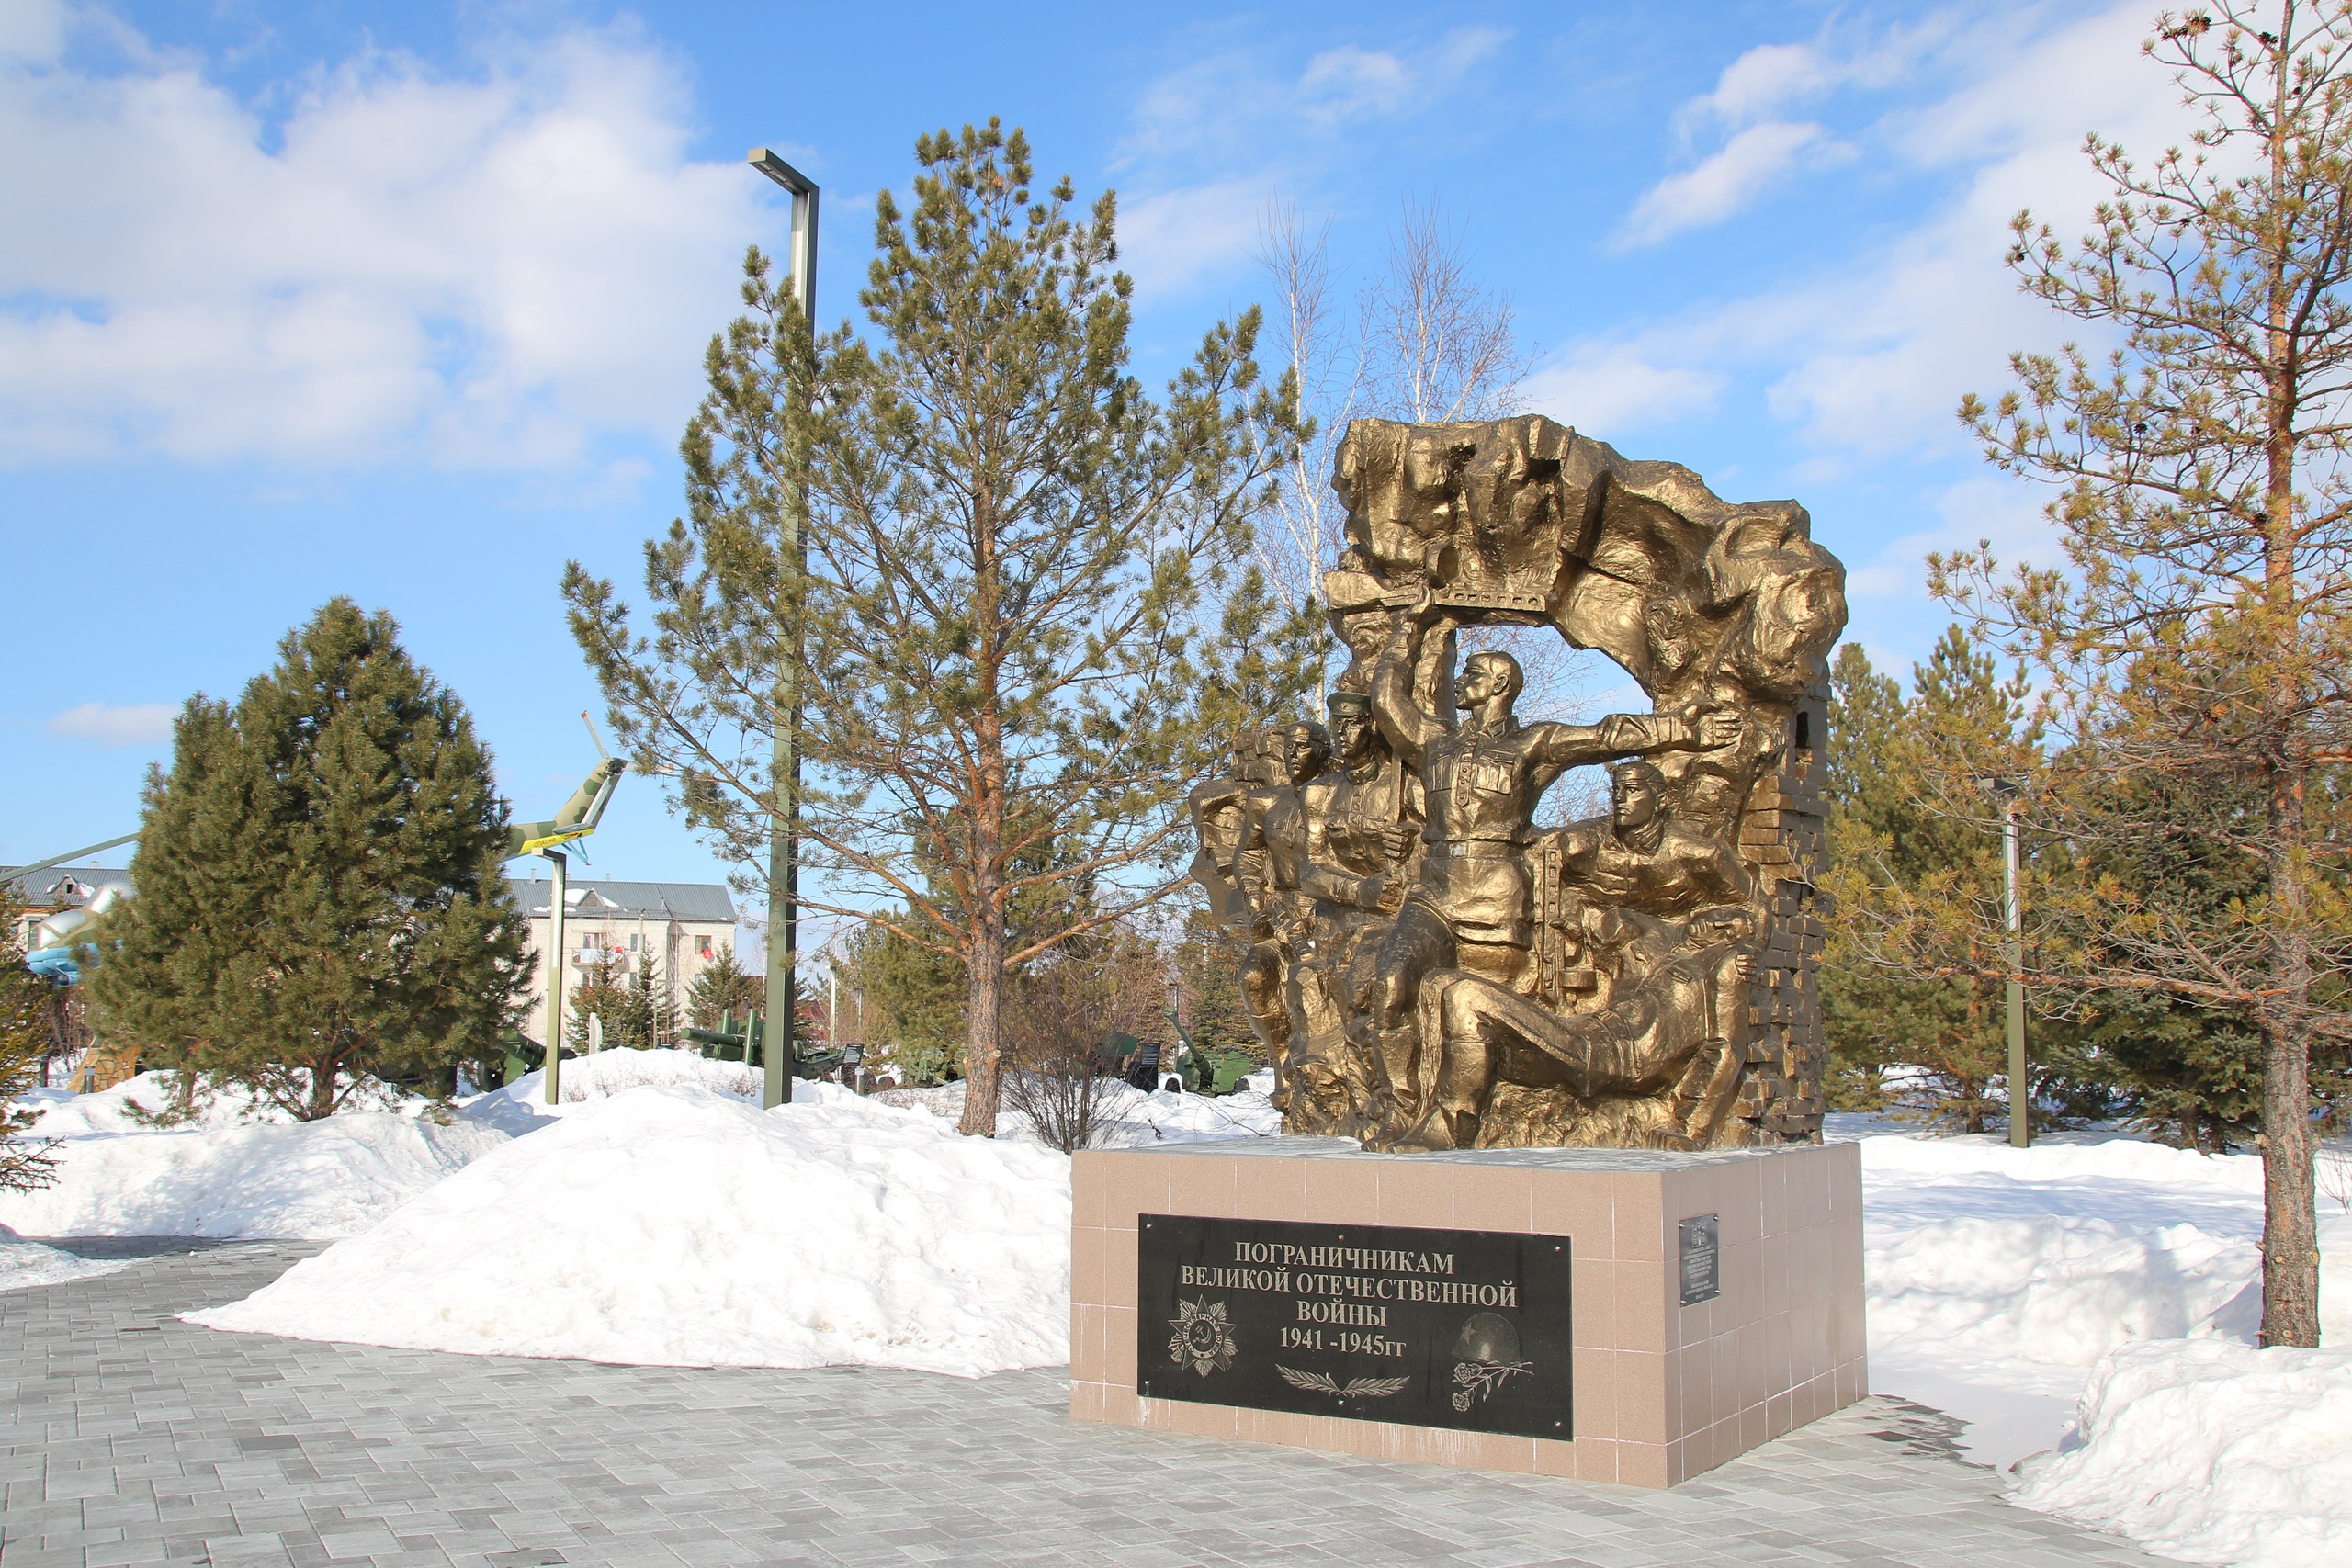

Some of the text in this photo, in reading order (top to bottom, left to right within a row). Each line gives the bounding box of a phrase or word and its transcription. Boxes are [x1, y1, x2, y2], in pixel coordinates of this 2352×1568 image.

[534, 838, 556, 847] ОПАСНО
[1235, 1241, 1454, 1275] ПОГРАНИЧНИКАМ
[1181, 1265, 1518, 1308] ВЕЛИКОЙ ОТЕЧЕСТВЕННОЙ
[1296, 1297, 1388, 1327] ВОЙНЫ
[1280, 1326, 1407, 1358] 1941 -1945гг
